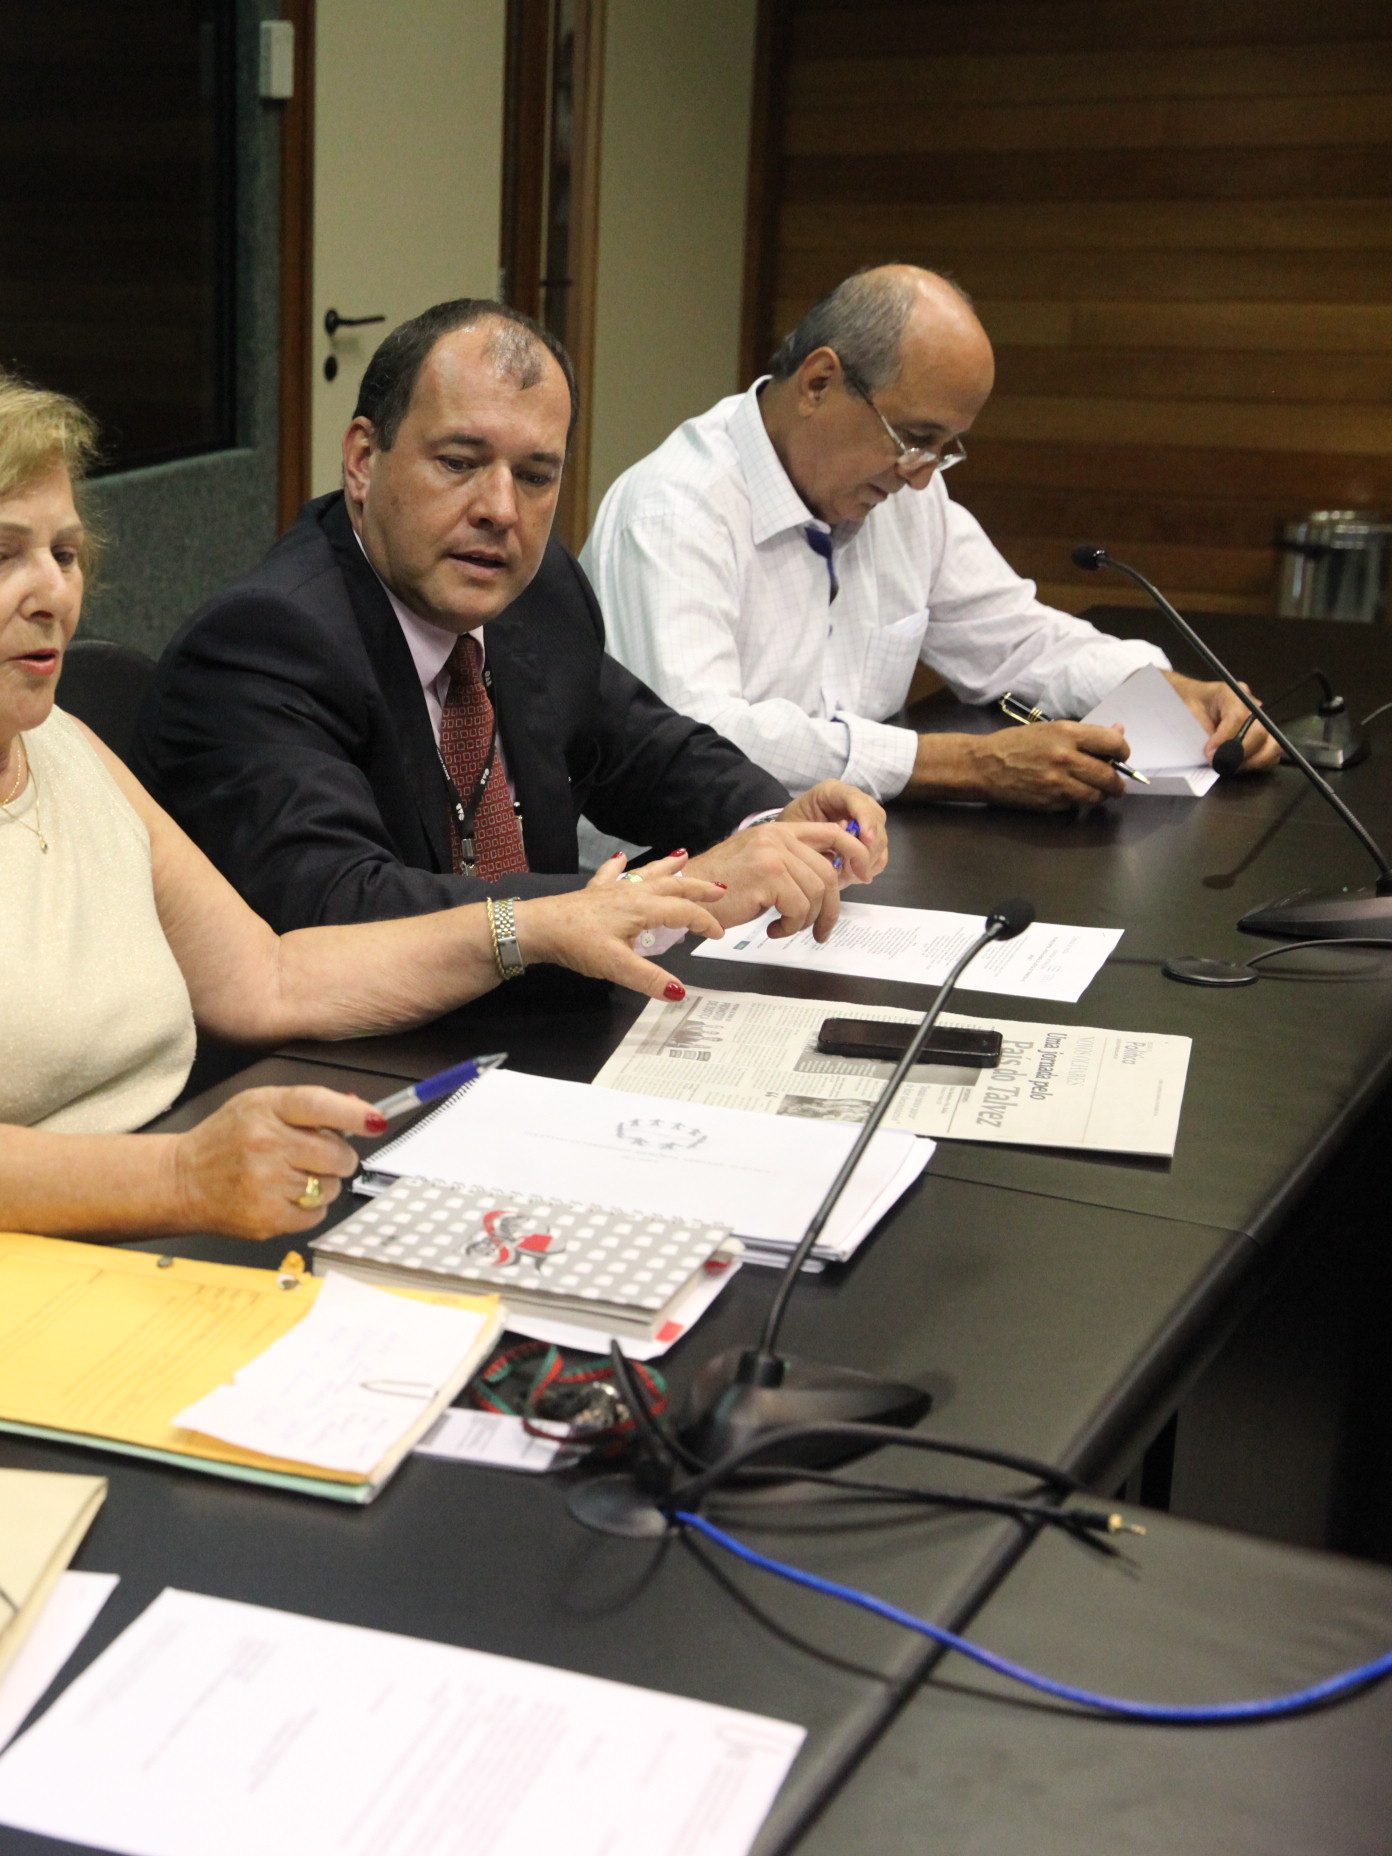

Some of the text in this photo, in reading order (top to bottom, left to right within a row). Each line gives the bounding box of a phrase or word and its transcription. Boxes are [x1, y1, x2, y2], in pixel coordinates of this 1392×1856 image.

[456, 803, 465, 821] OAB
[976, 1039, 1034, 1128] País do Talvez
[1029, 1032, 1067, 1100] Uma jornada pelo
